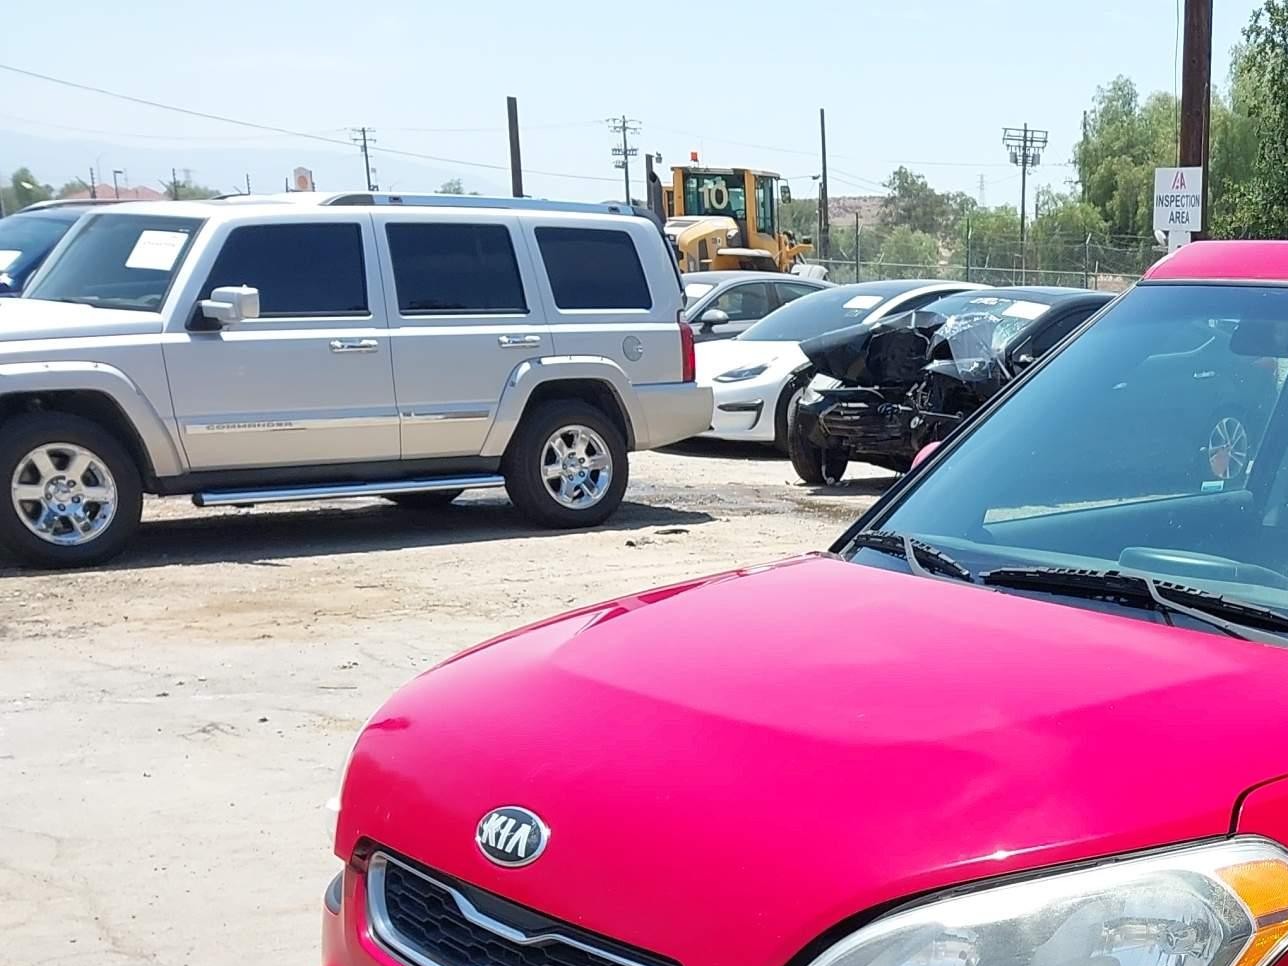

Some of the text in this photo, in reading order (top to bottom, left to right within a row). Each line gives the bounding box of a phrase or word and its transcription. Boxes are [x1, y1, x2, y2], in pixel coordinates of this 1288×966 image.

[699, 180, 729, 210] 10
[1155, 194, 1200, 208] INSPECTION
[1168, 211, 1190, 224] AREA
[481, 812, 532, 858] KIA
